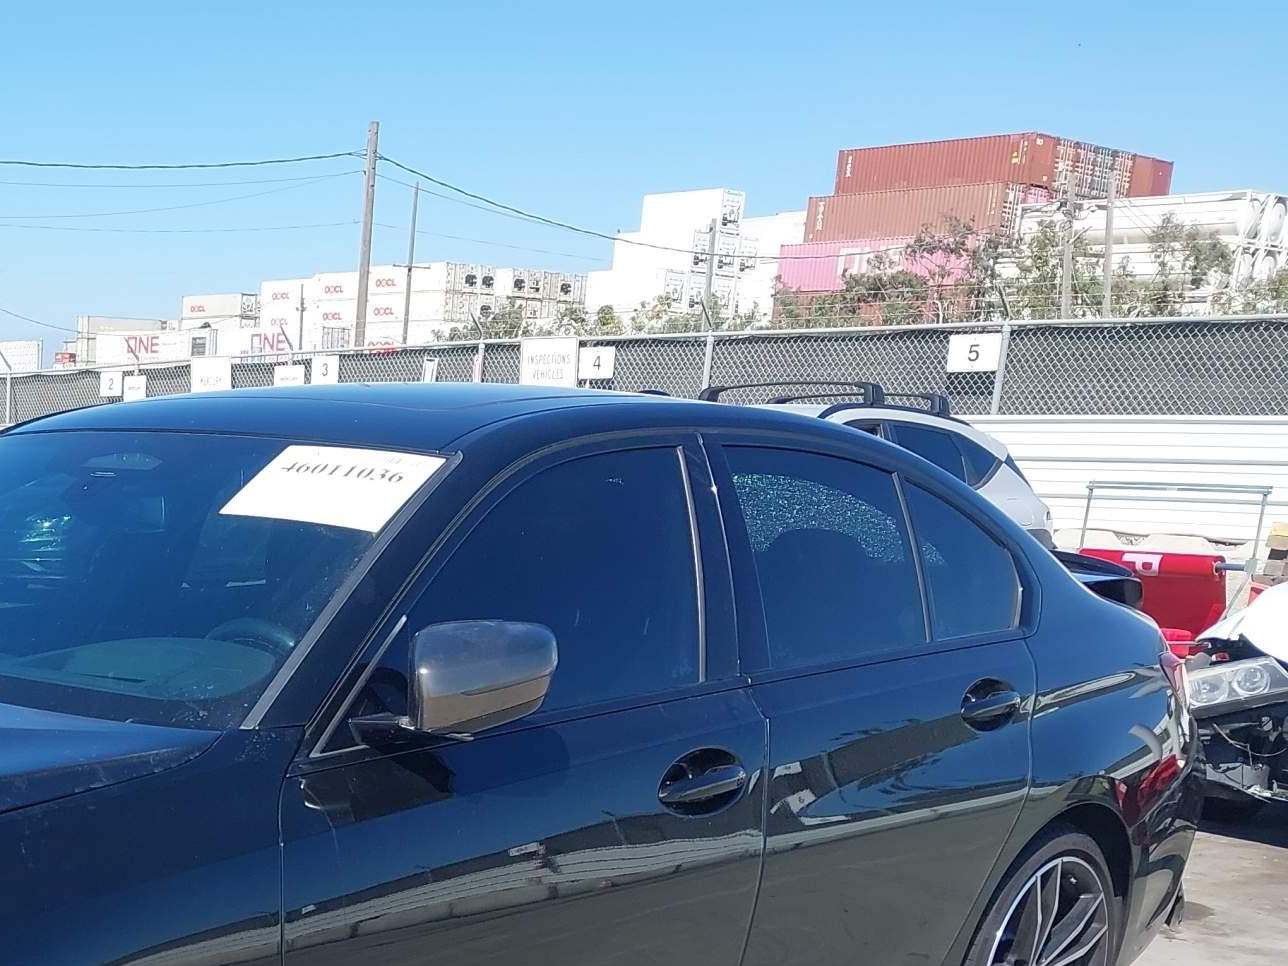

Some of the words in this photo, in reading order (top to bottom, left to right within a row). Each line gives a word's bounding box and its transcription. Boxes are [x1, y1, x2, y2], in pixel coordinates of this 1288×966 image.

[967, 344, 980, 362] 5
[321, 363, 329, 377] 3
[592, 355, 601, 371] 4
[108, 378, 114, 391] 2
[280, 461, 404, 483] 46011036
